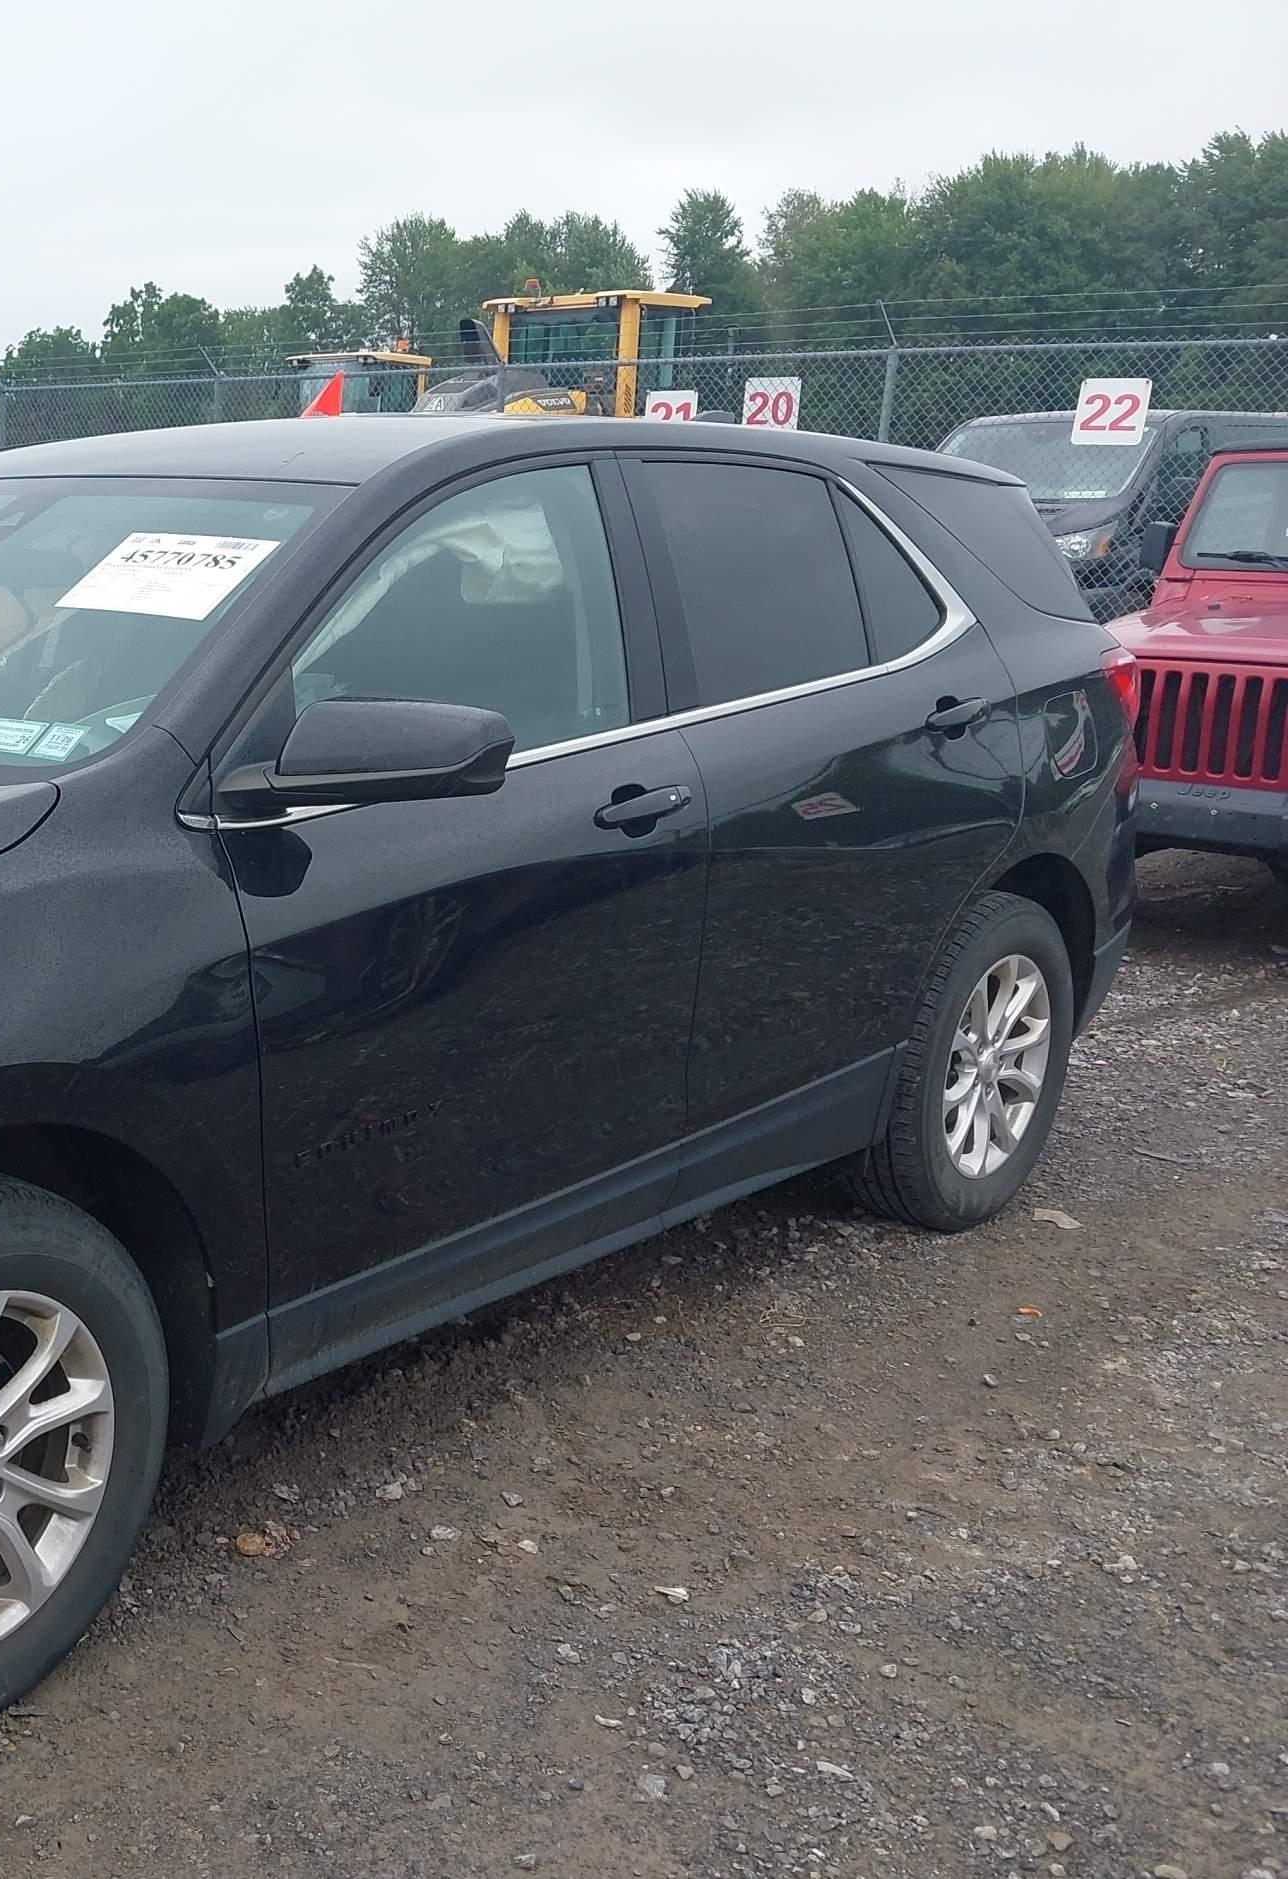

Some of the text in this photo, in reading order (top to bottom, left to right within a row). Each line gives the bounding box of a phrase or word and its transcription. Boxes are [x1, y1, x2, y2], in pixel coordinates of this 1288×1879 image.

[536, 397, 572, 407] VOLVO
[650, 401, 692, 421] 21
[746, 391, 794, 425] 20
[1079, 393, 1141, 431] 22
[121, 549, 243, 570] 45770785
[1176, 783, 1232, 801] Jeep
